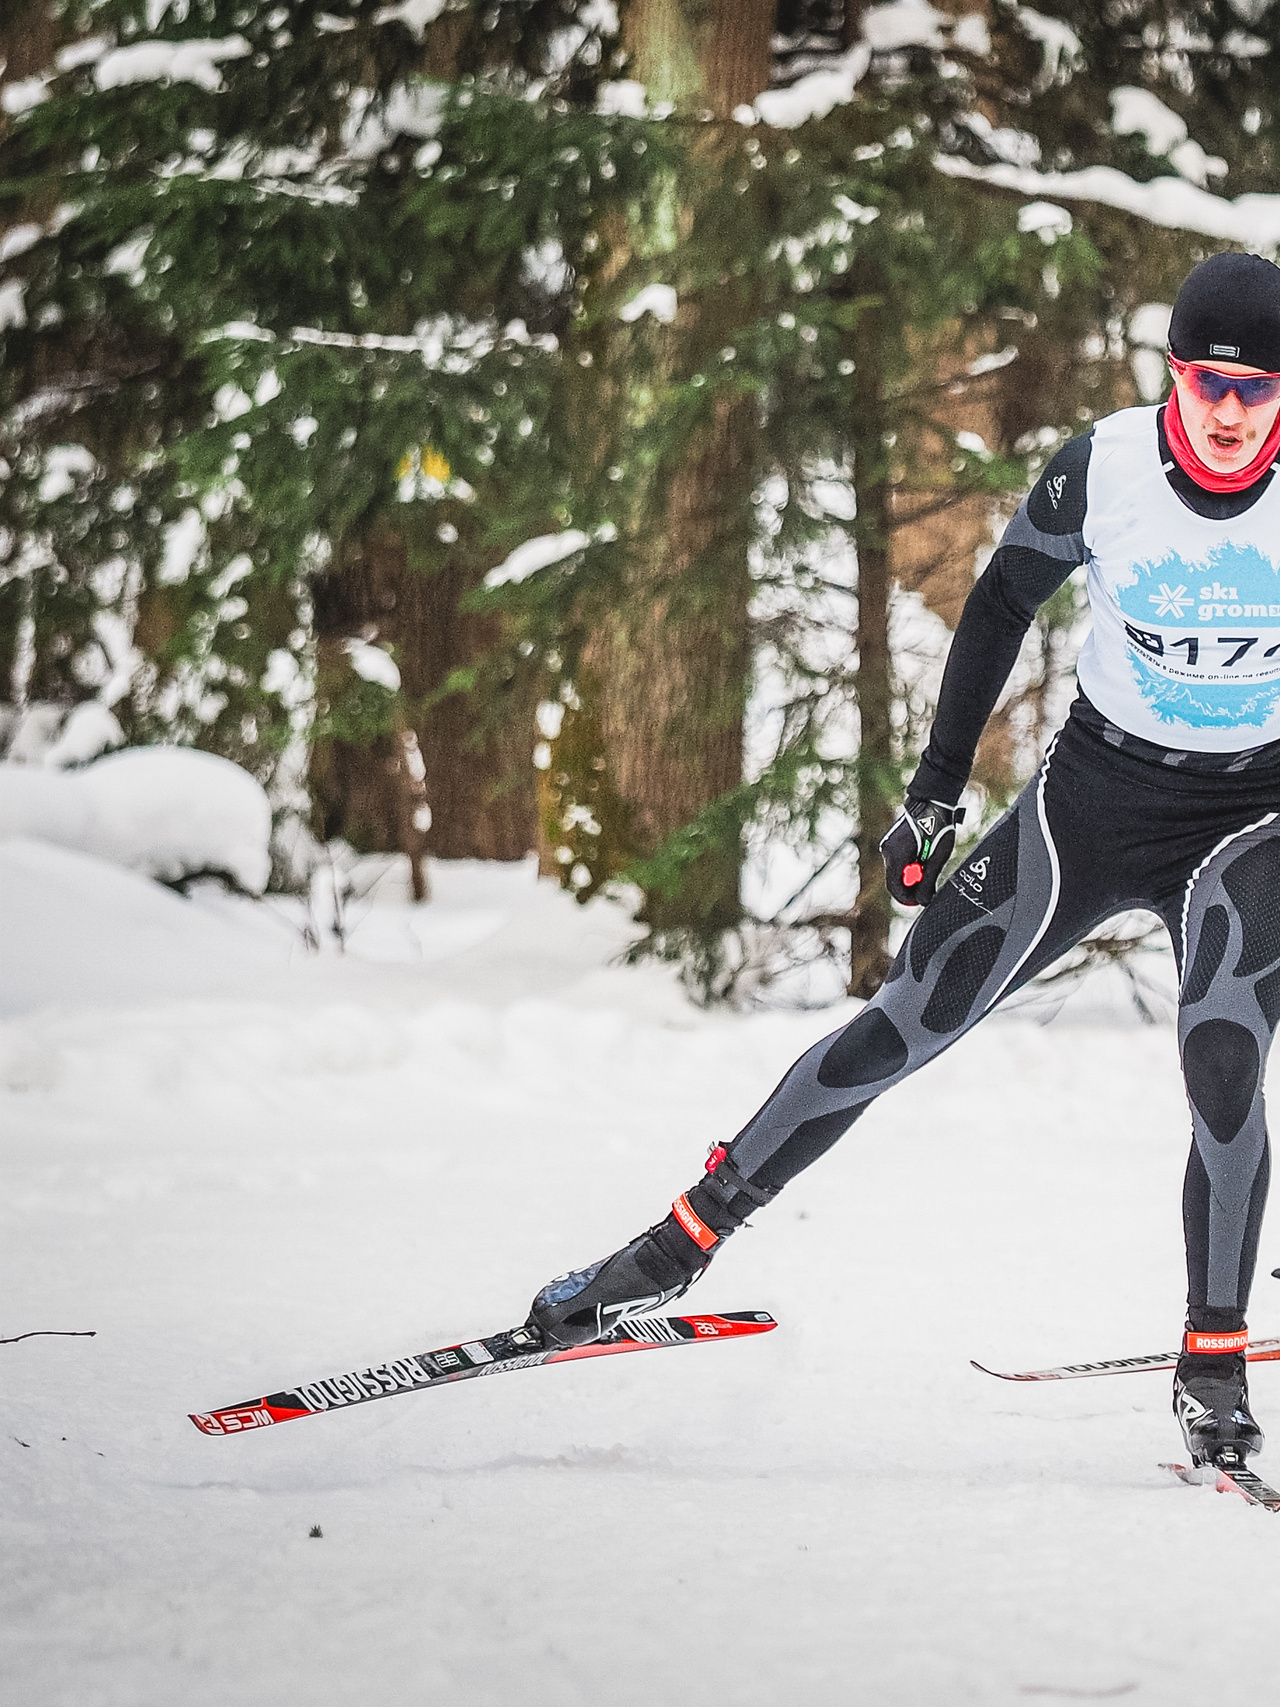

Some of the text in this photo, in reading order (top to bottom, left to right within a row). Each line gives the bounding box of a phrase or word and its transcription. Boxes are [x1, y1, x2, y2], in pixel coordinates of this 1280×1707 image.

[1198, 582, 1239, 600] ski
[1197, 603, 1268, 621] grom
[674, 1199, 702, 1238] SSIGNOL
[478, 1351, 549, 1377] ROSSIGNOL
[1059, 1351, 1181, 1374] OSSIGNOL
[284, 1357, 430, 1412] ROSSIGNOL
[220, 1408, 275, 1431] WCS
